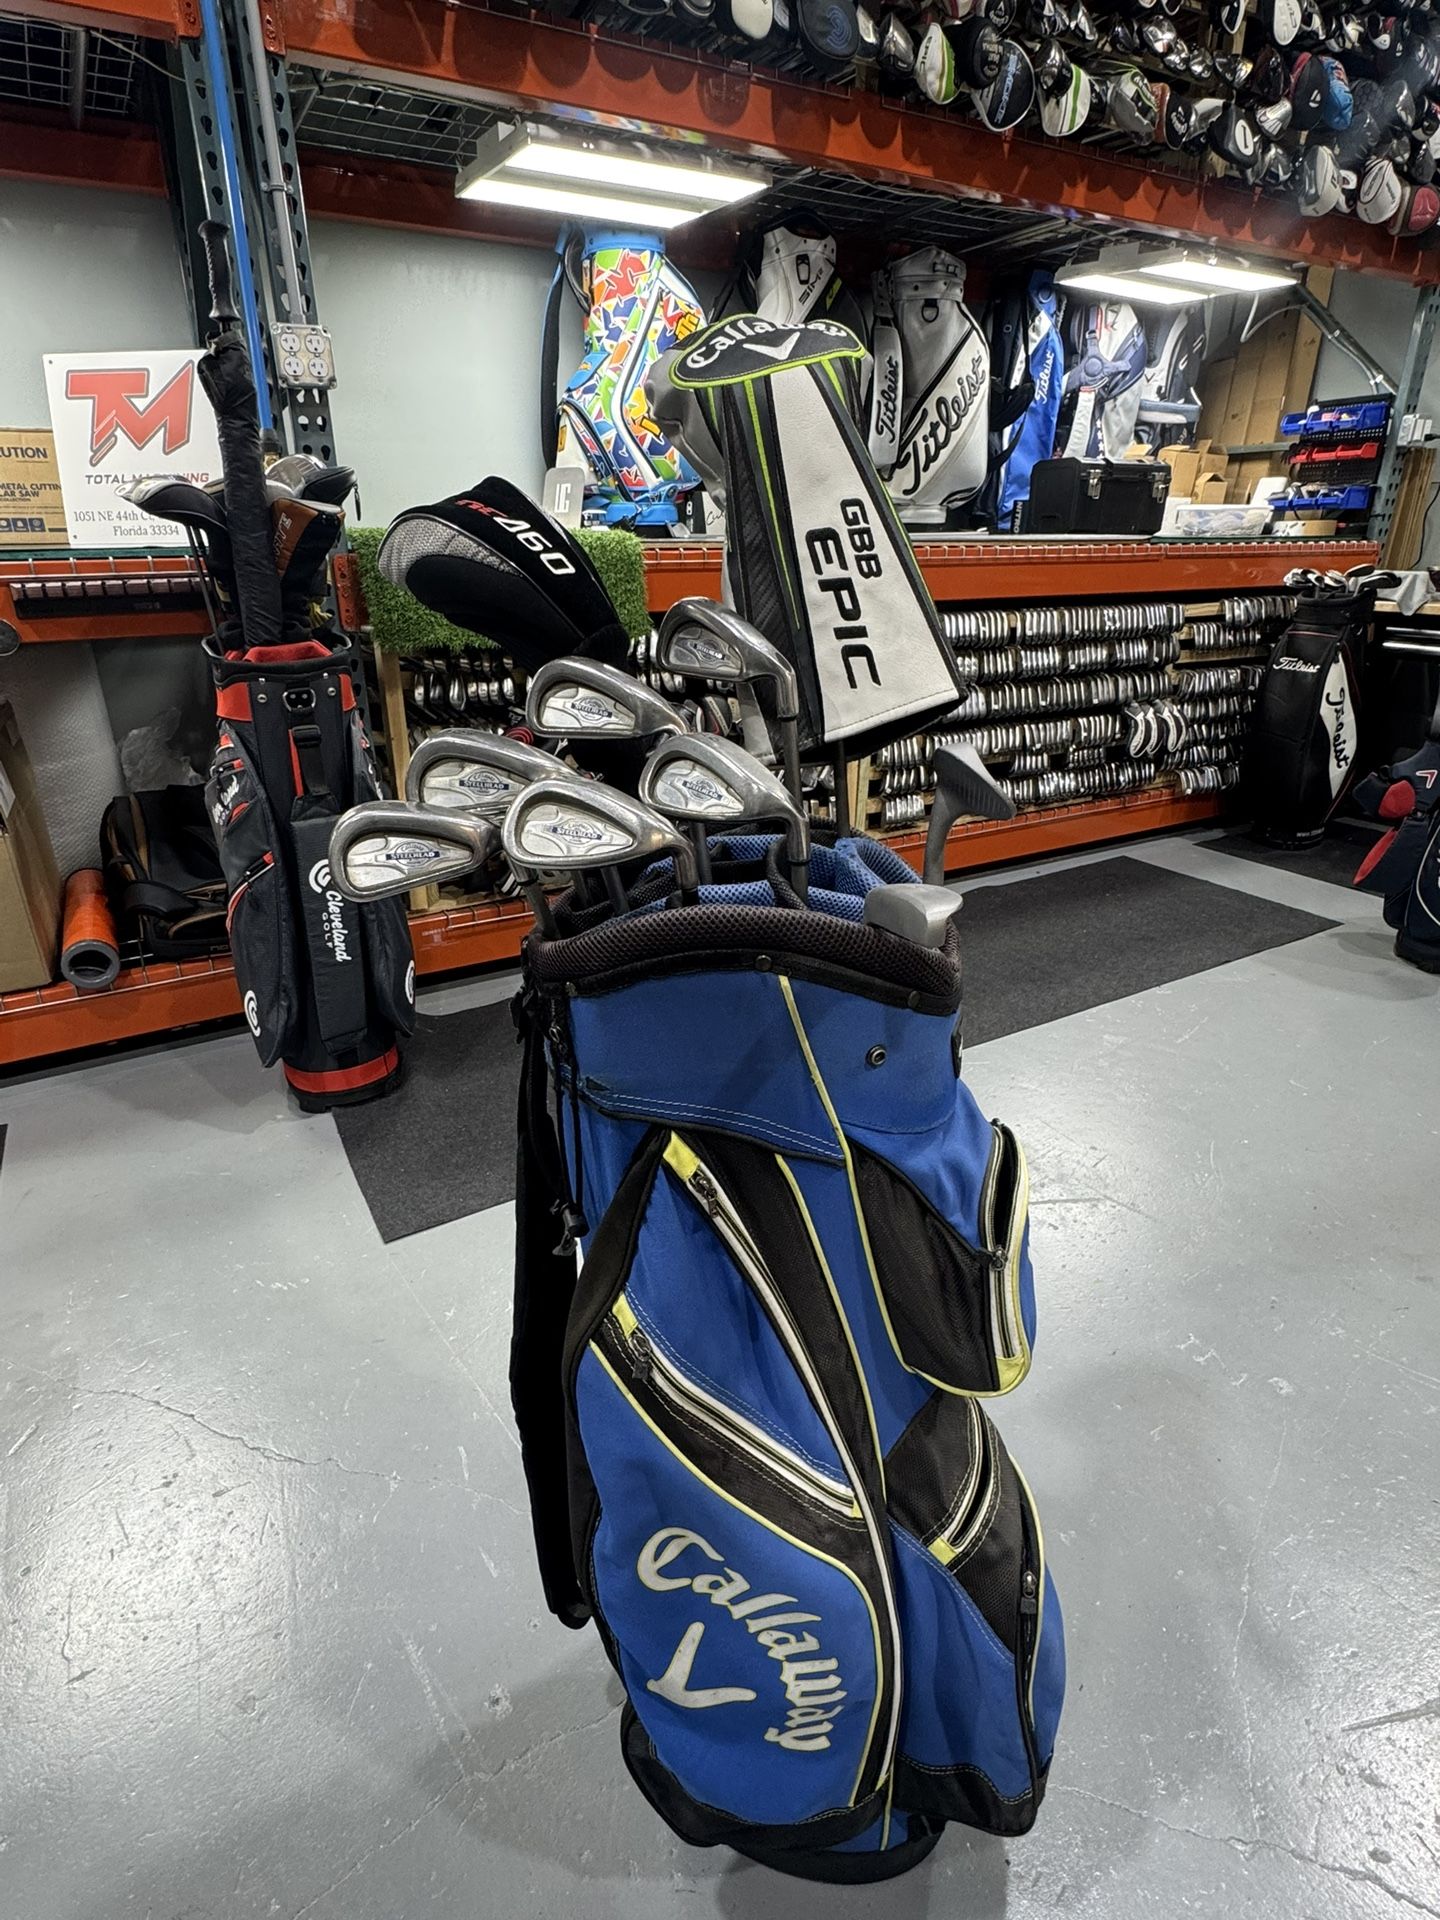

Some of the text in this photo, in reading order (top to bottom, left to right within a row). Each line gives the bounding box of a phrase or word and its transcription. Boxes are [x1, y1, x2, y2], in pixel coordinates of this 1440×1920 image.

[686, 320, 847, 369] Callaway
[65, 360, 194, 467] TM
[876, 355, 899, 444] Titleist
[895, 354, 986, 496] Titleist
[85, 474, 126, 484] TOTAL
[74, 511, 95, 522] 1051
[98, 511, 114, 521] NE
[116, 511, 139, 521] 44th
[113, 525, 179, 537] Florida 33334
[840, 498, 882, 579] GBB
[1013, 501, 1023, 533] NITRO
[805, 527, 882, 689] EPIC
[1272, 656, 1321, 673] Titleist
[322, 912, 334, 949] GOLF
[325, 890, 352, 962] Cleveland
[636, 1527, 848, 1751] Callaway
